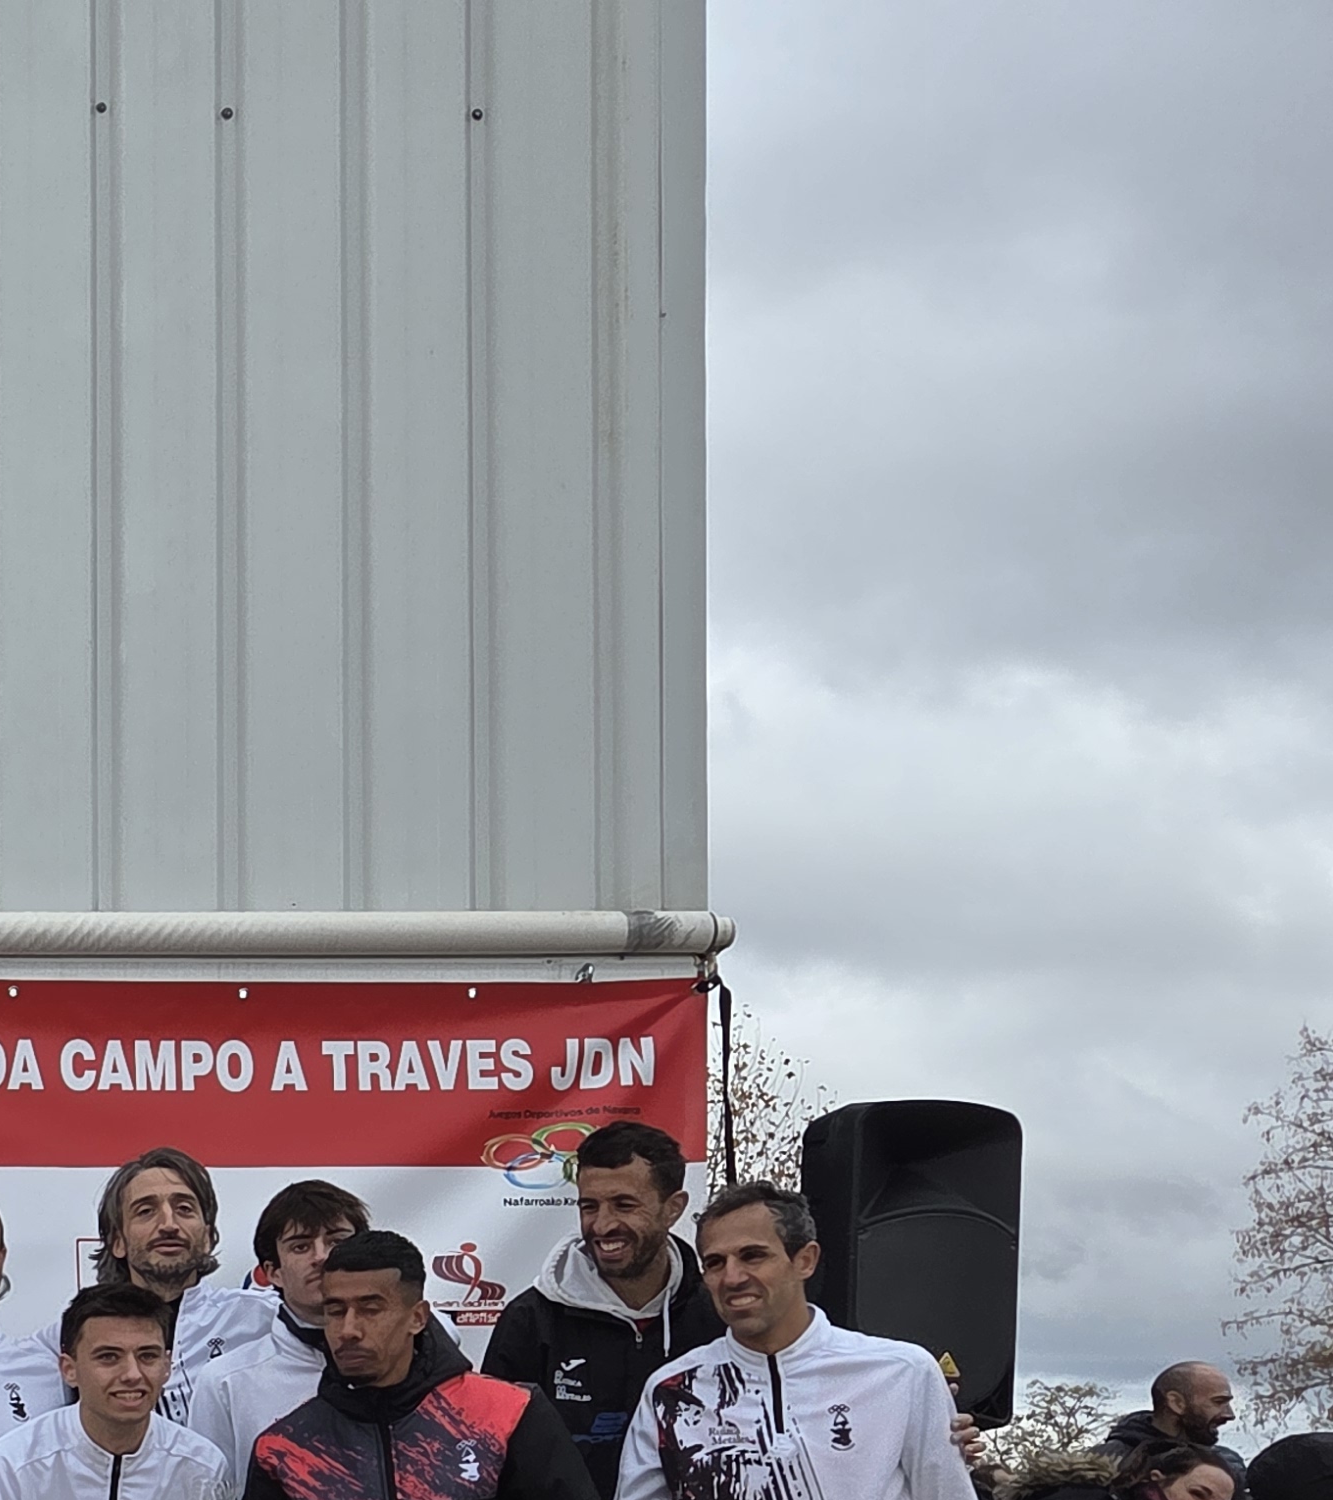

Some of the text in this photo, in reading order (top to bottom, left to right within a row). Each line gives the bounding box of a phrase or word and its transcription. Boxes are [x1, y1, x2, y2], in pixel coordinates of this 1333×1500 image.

[60, 1038, 254, 1092] CAMPO
[270, 1040, 308, 1092] A
[322, 1039, 534, 1092] TRAVES
[550, 1035, 656, 1090] JDN
